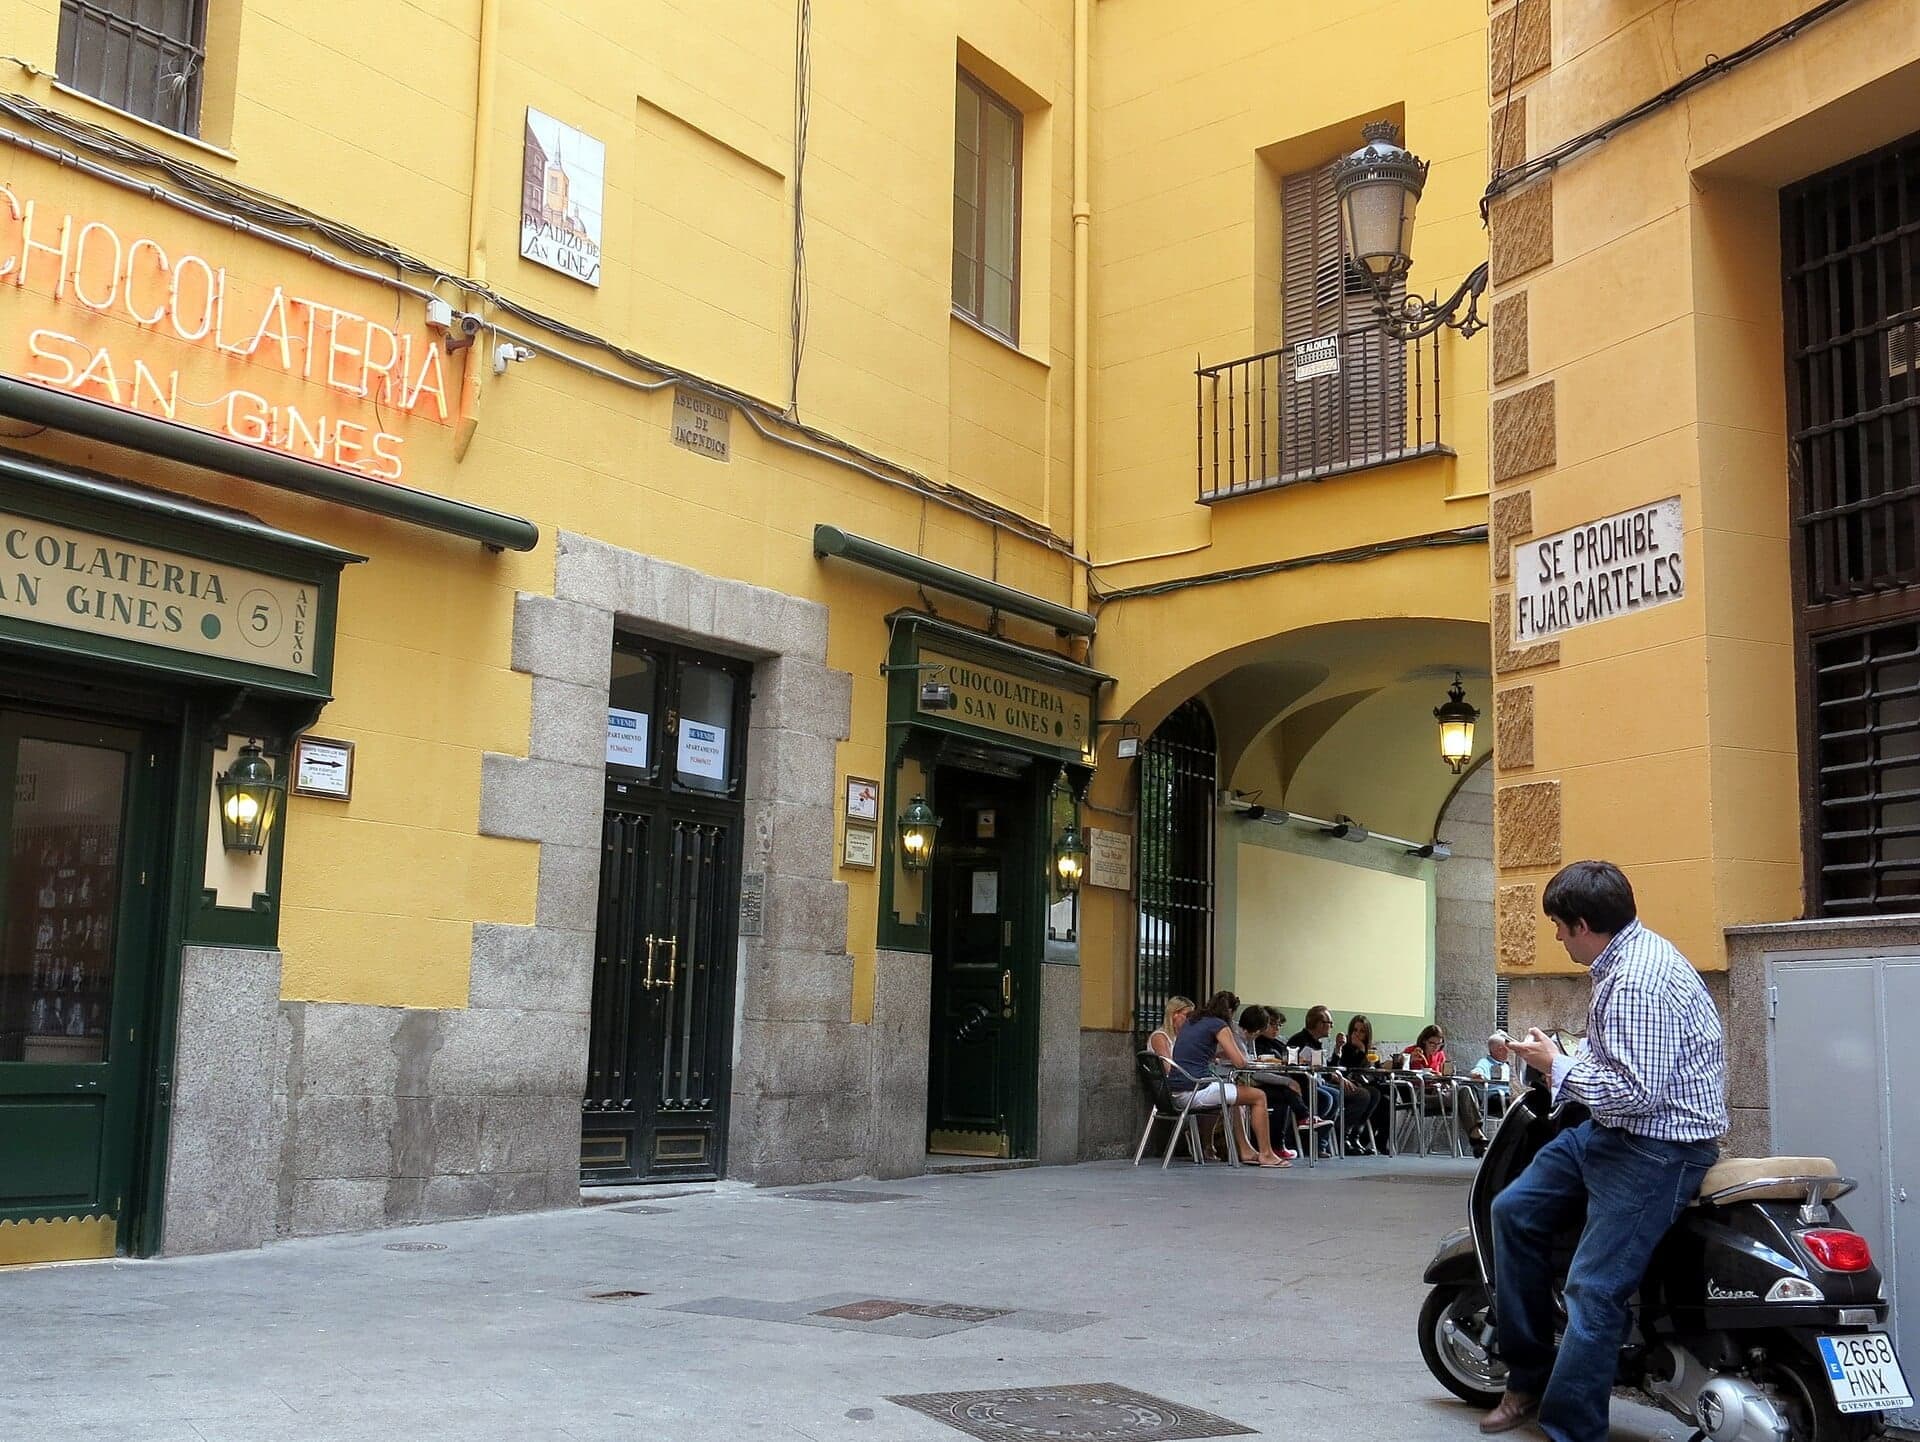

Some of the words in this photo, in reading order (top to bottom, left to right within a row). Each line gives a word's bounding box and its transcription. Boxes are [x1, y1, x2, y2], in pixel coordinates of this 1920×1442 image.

[524, 213, 583, 252] PASADIZO
[586, 243, 600, 258] DE
[523, 236, 548, 260] SAN
[557, 247, 600, 281] GINES
[25, 328, 179, 419] SAN
[226, 389, 403, 479] GINES
[675, 426, 726, 455] INCENDIOS
[695, 416, 708, 431] DE
[1538, 539, 1565, 584] SE
[1573, 509, 1660, 574] PROHIBE
[6, 529, 228, 604] COLATERIA
[0, 572, 41, 606] N
[67, 585, 183, 633] GINES
[1518, 585, 1570, 635] FIJAR
[1573, 552, 1682, 620] CARTELES
[251, 605, 271, 632] 5
[292, 588, 309, 665] ANEXO
[949, 666, 1065, 714] CHOCOLATERIA
[964, 697, 997, 721] SAN
[1006, 707, 1049, 735] GINES
[1072, 713, 1081, 730] 5
[1707, 1278, 1759, 1300] Vespa
[1831, 1364, 1839, 1373] E
[1837, 1338, 1892, 1367] 2668
[1845, 1368, 1890, 1397] HNX
[1848, 1401, 1873, 1410] VESPA
[1875, 1399, 1905, 1408] MADRID
